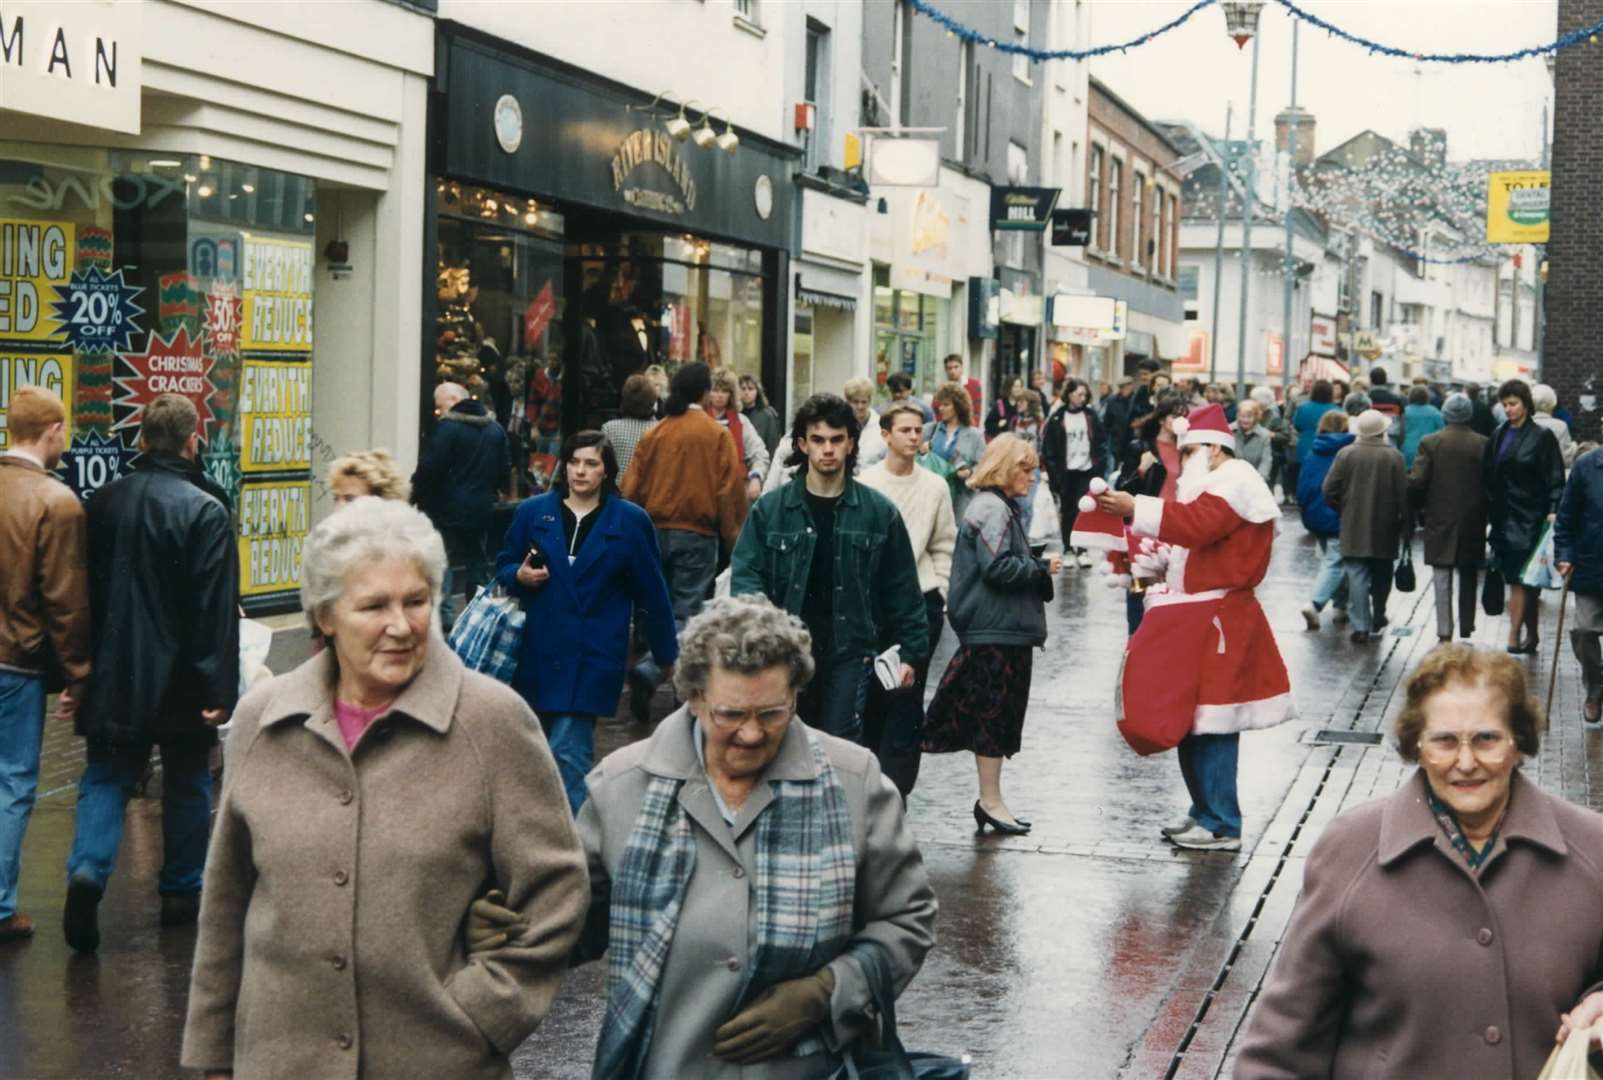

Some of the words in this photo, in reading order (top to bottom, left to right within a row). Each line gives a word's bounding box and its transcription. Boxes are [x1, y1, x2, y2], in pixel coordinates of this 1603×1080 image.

[0, 10, 117, 88] MAN
[4, 224, 66, 280] ING
[70, 291, 122, 325] 20%
[80, 325, 116, 336] OFF
